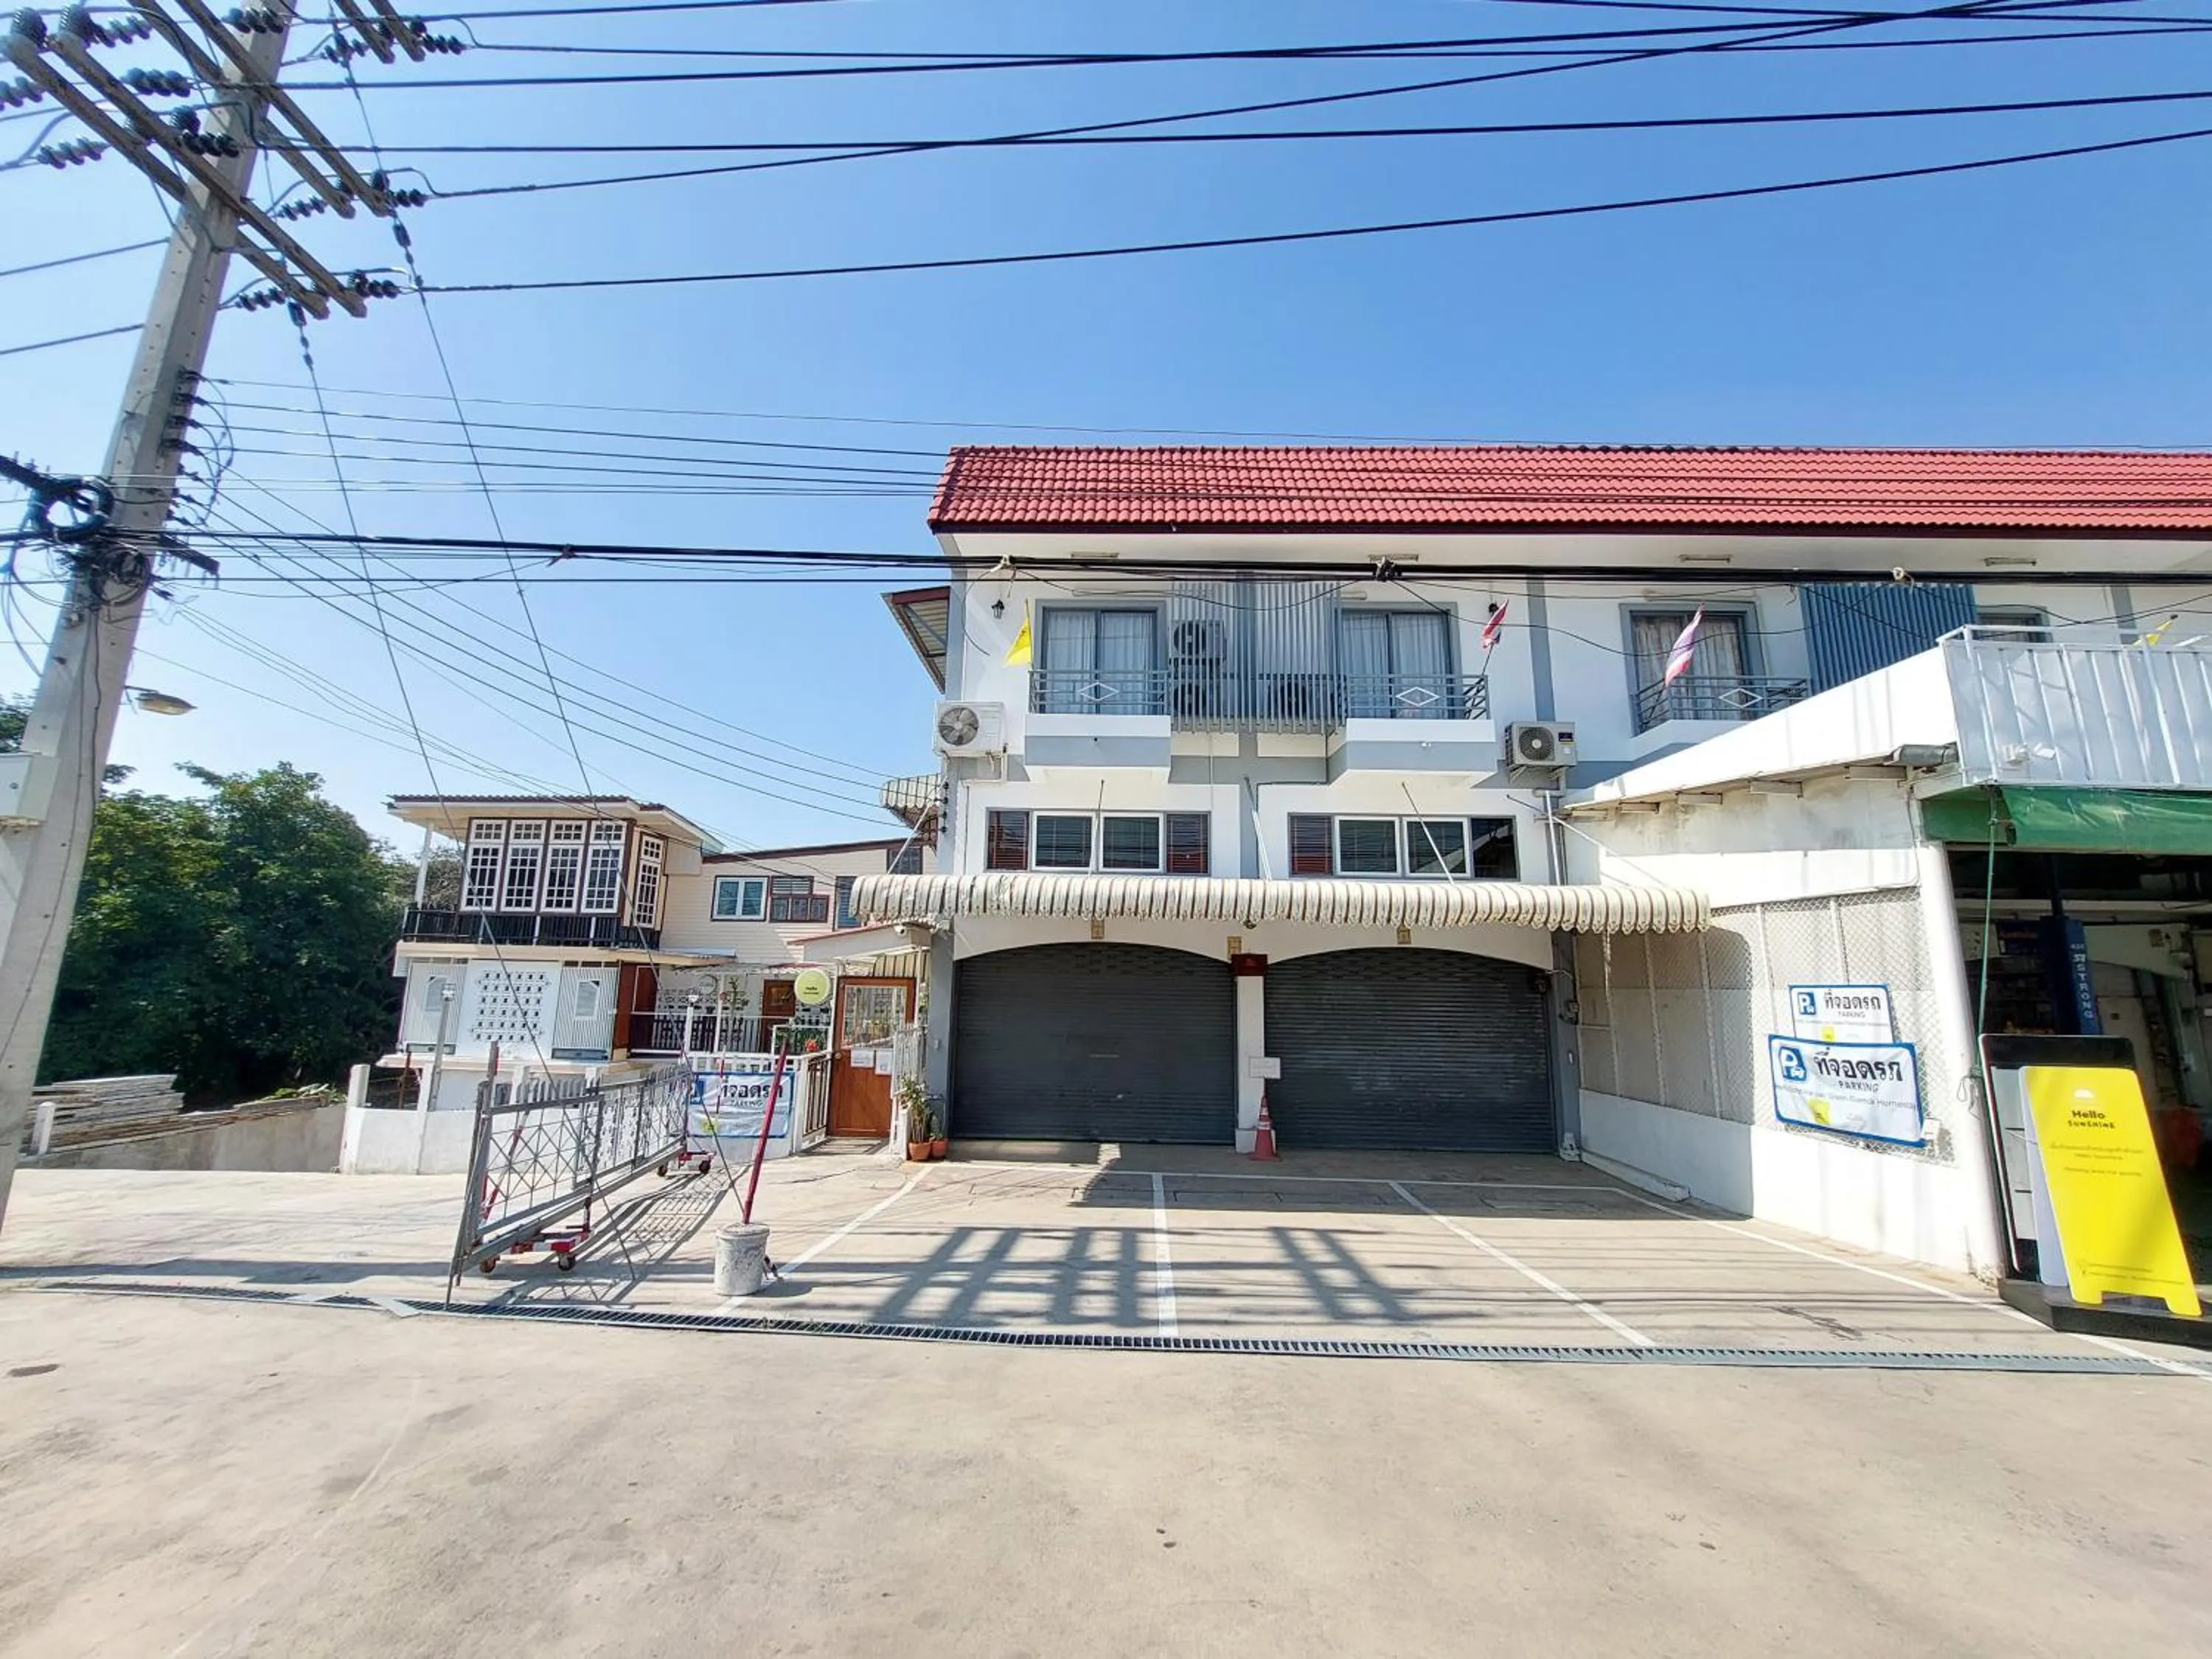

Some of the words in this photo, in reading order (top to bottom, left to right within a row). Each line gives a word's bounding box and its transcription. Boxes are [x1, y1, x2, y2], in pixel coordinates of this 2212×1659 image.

[1823, 989, 1881, 1010] ที่จอดรถ
[1837, 1011, 1866, 1019] PARKING
[1813, 1046, 1903, 1081] ที่จอดรถ
[1839, 1081, 1879, 1093] PARKING
[2071, 1110, 2106, 1119] Hello
